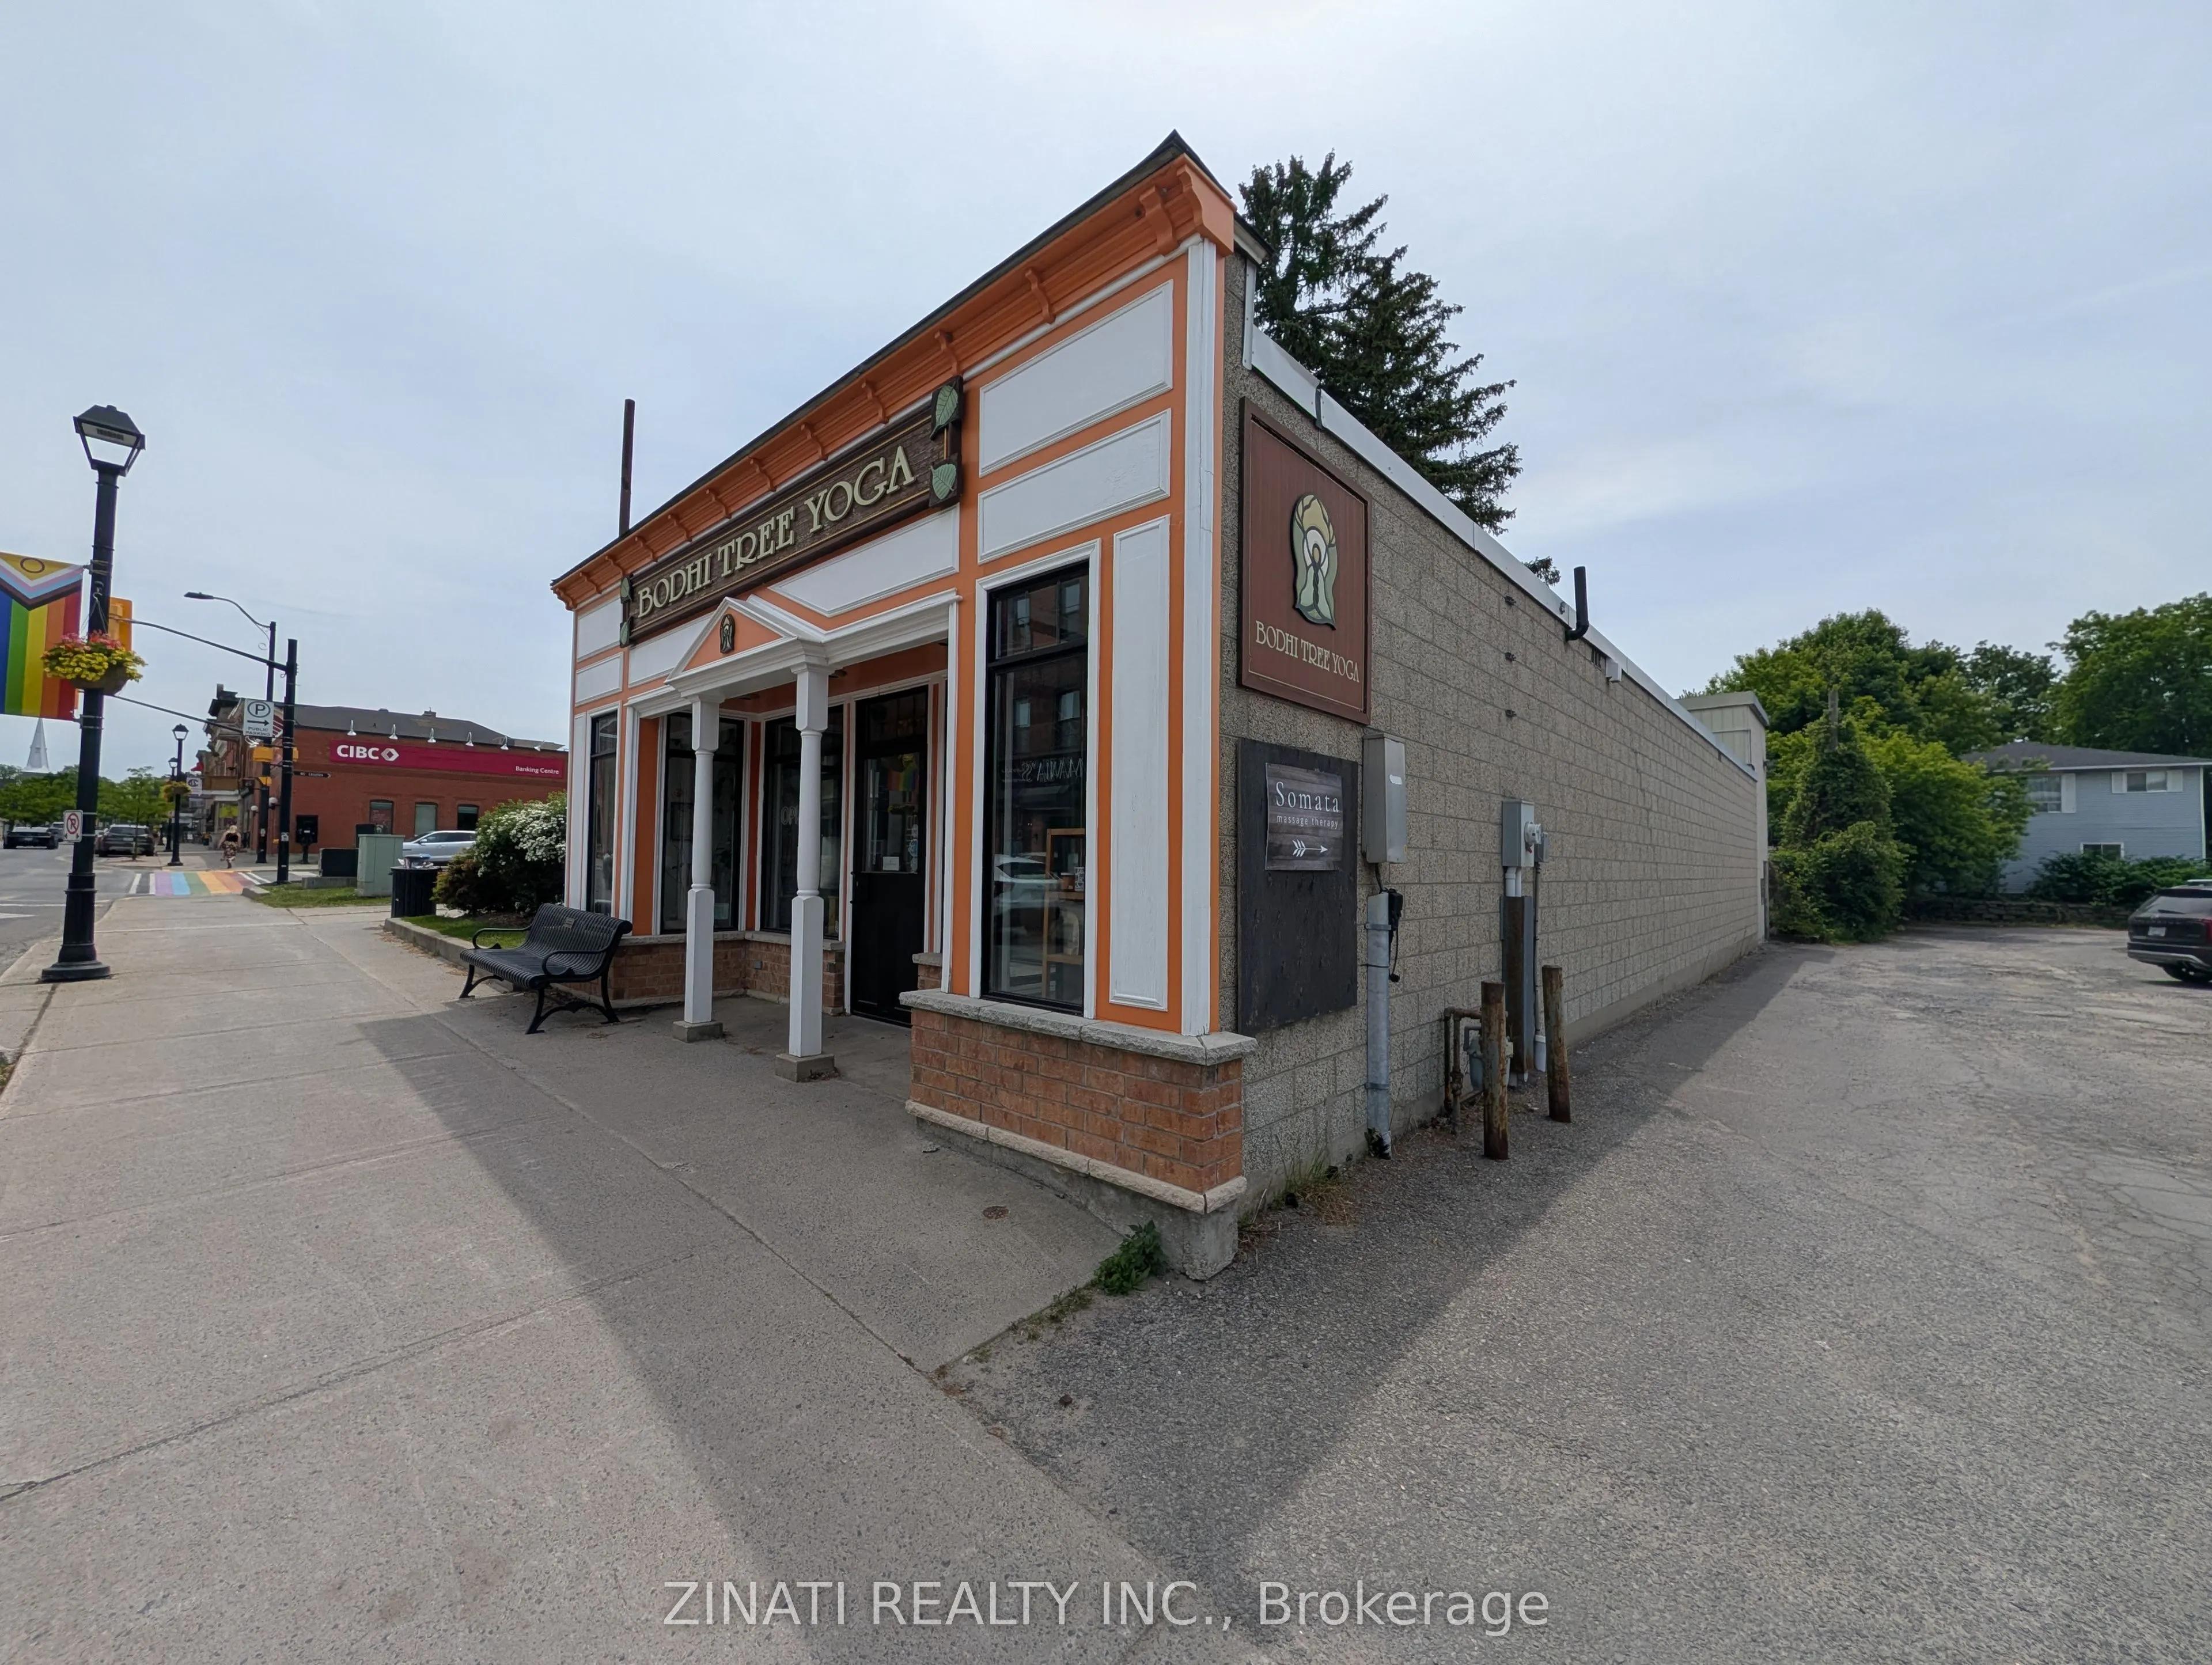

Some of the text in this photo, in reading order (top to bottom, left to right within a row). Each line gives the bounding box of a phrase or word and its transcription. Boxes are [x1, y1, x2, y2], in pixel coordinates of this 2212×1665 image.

[638, 445, 915, 619] BODHI TREE YOGA
[1255, 620, 1360, 682] BODHI TREE YOGA
[336, 745, 380, 760] CIBC
[516, 766, 539, 774] Banking
[1276, 781, 1339, 813] Somata
[1277, 815, 1338, 830] massage therapy
